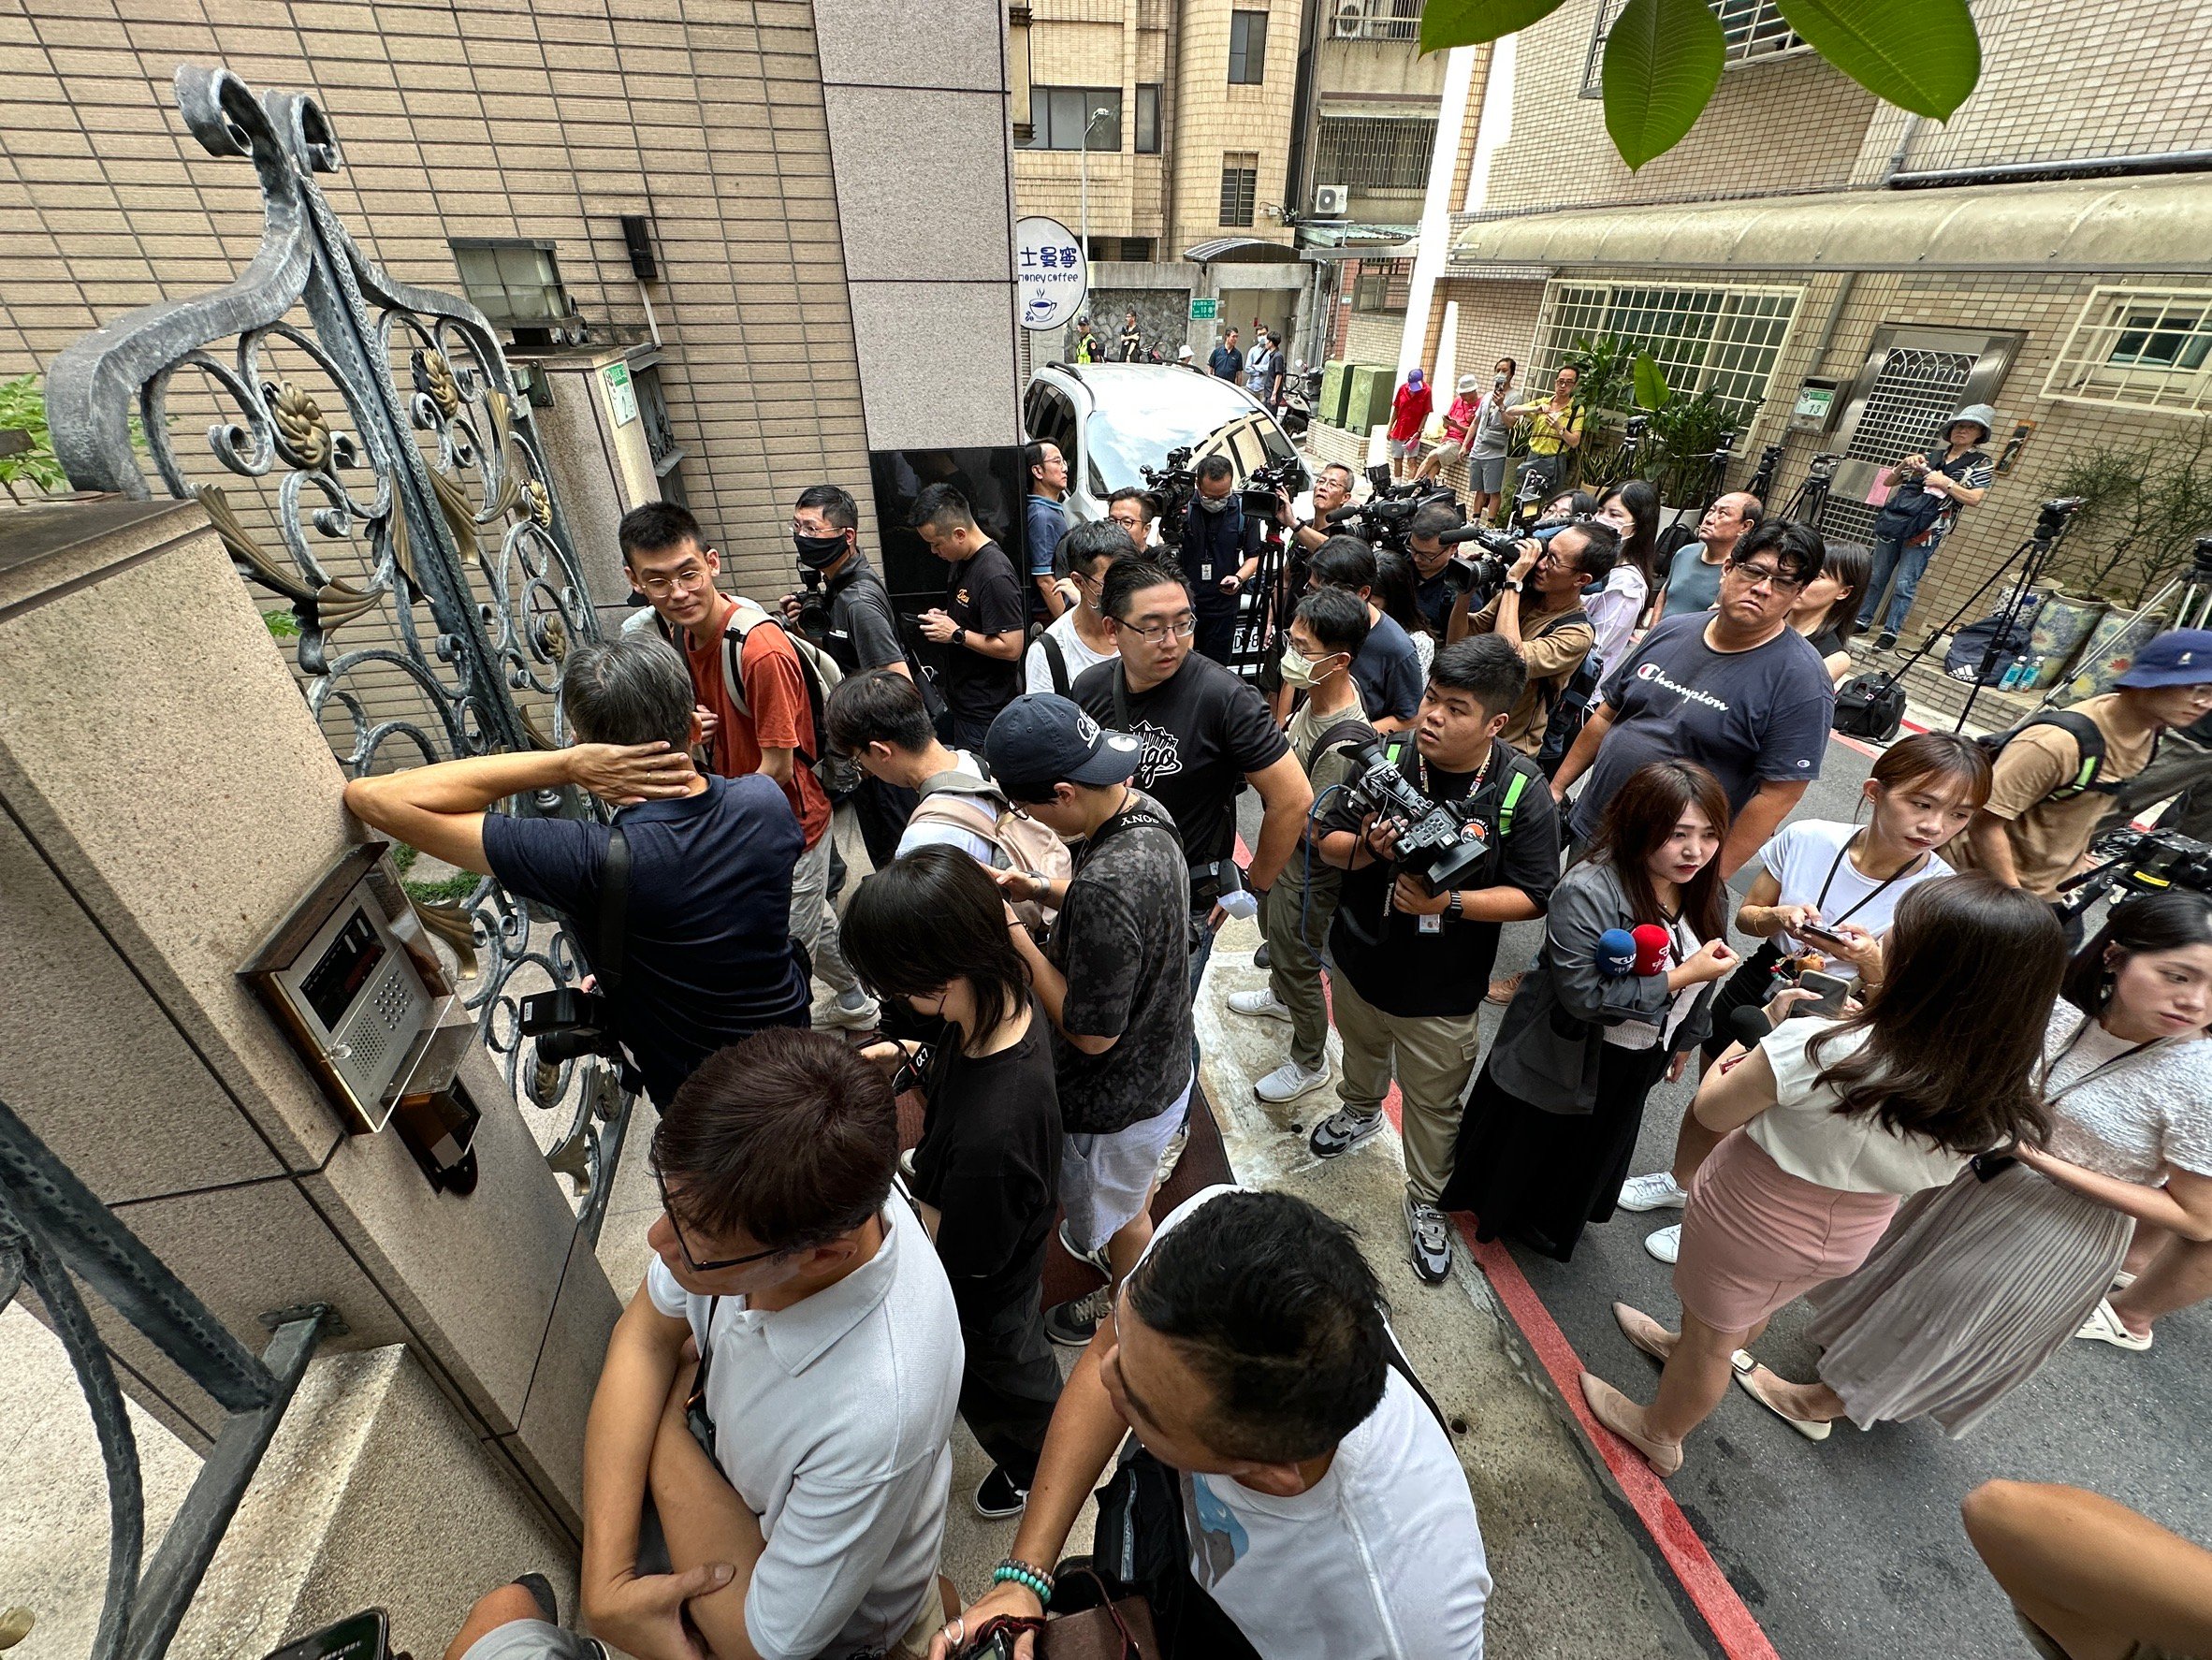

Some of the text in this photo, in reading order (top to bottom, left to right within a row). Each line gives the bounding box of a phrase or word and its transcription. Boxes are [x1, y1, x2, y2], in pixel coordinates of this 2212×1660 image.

[1047, 272, 1079, 283] coffee
[1809, 404, 1822, 415] 13
[1637, 663, 1729, 712] Champion
